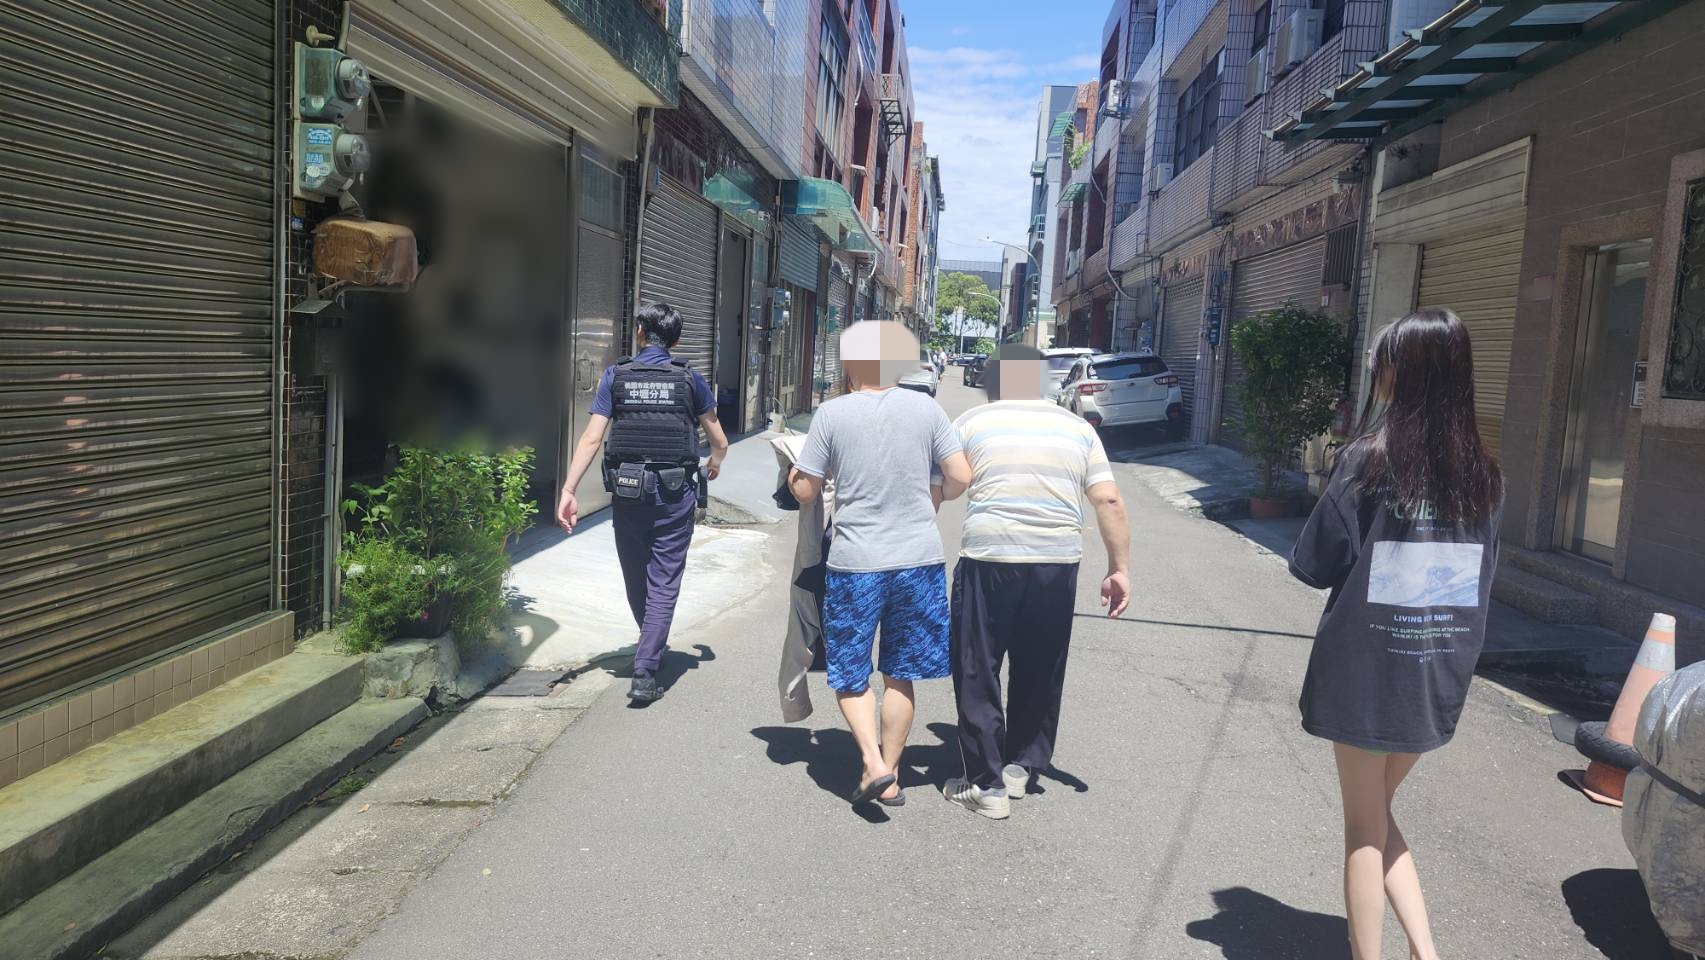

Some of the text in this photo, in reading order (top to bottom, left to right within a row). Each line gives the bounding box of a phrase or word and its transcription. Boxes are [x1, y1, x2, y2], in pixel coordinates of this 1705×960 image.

[629, 389, 669, 399] 中壢分局
[618, 477, 639, 486] POLICE
[1393, 614, 1423, 623] LIVING
